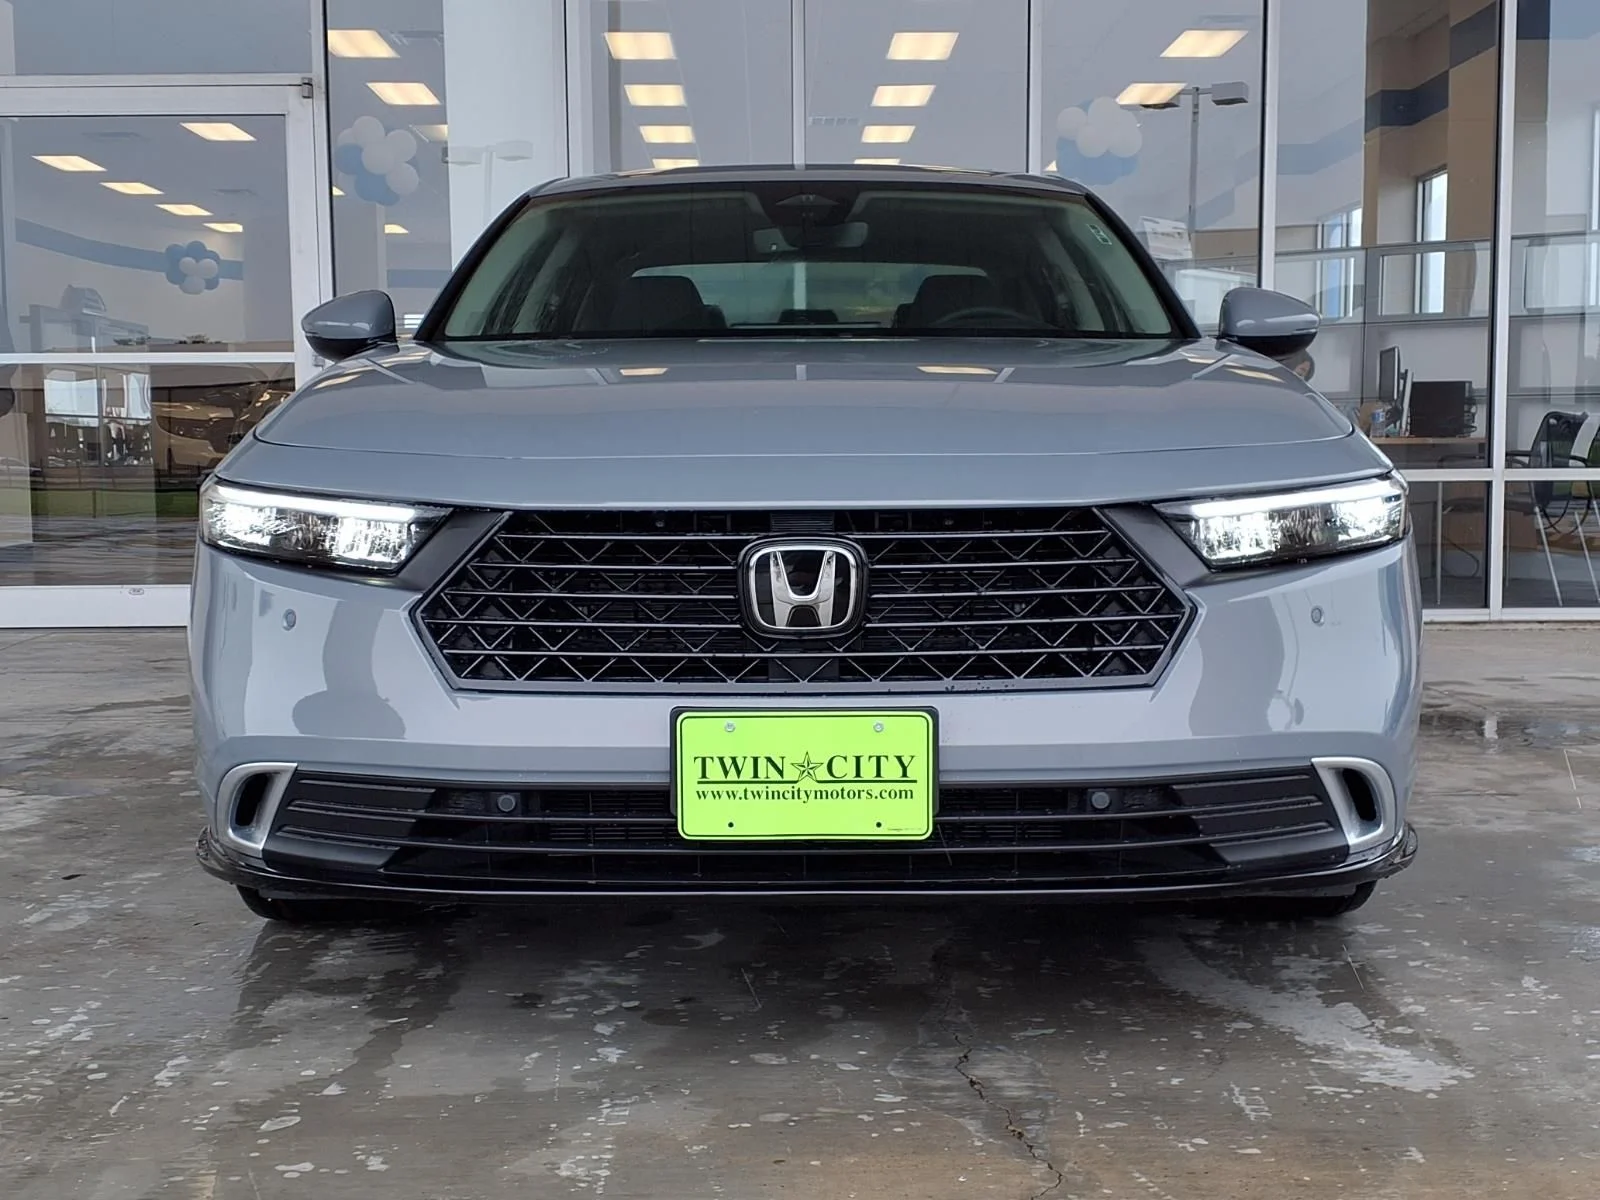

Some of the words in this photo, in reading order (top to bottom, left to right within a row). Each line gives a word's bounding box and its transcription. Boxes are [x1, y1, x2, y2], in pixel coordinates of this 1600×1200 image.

[693, 756, 786, 780] TWIN
[826, 755, 916, 779] CITY
[695, 785, 914, 804] www.twincitymotors.com
